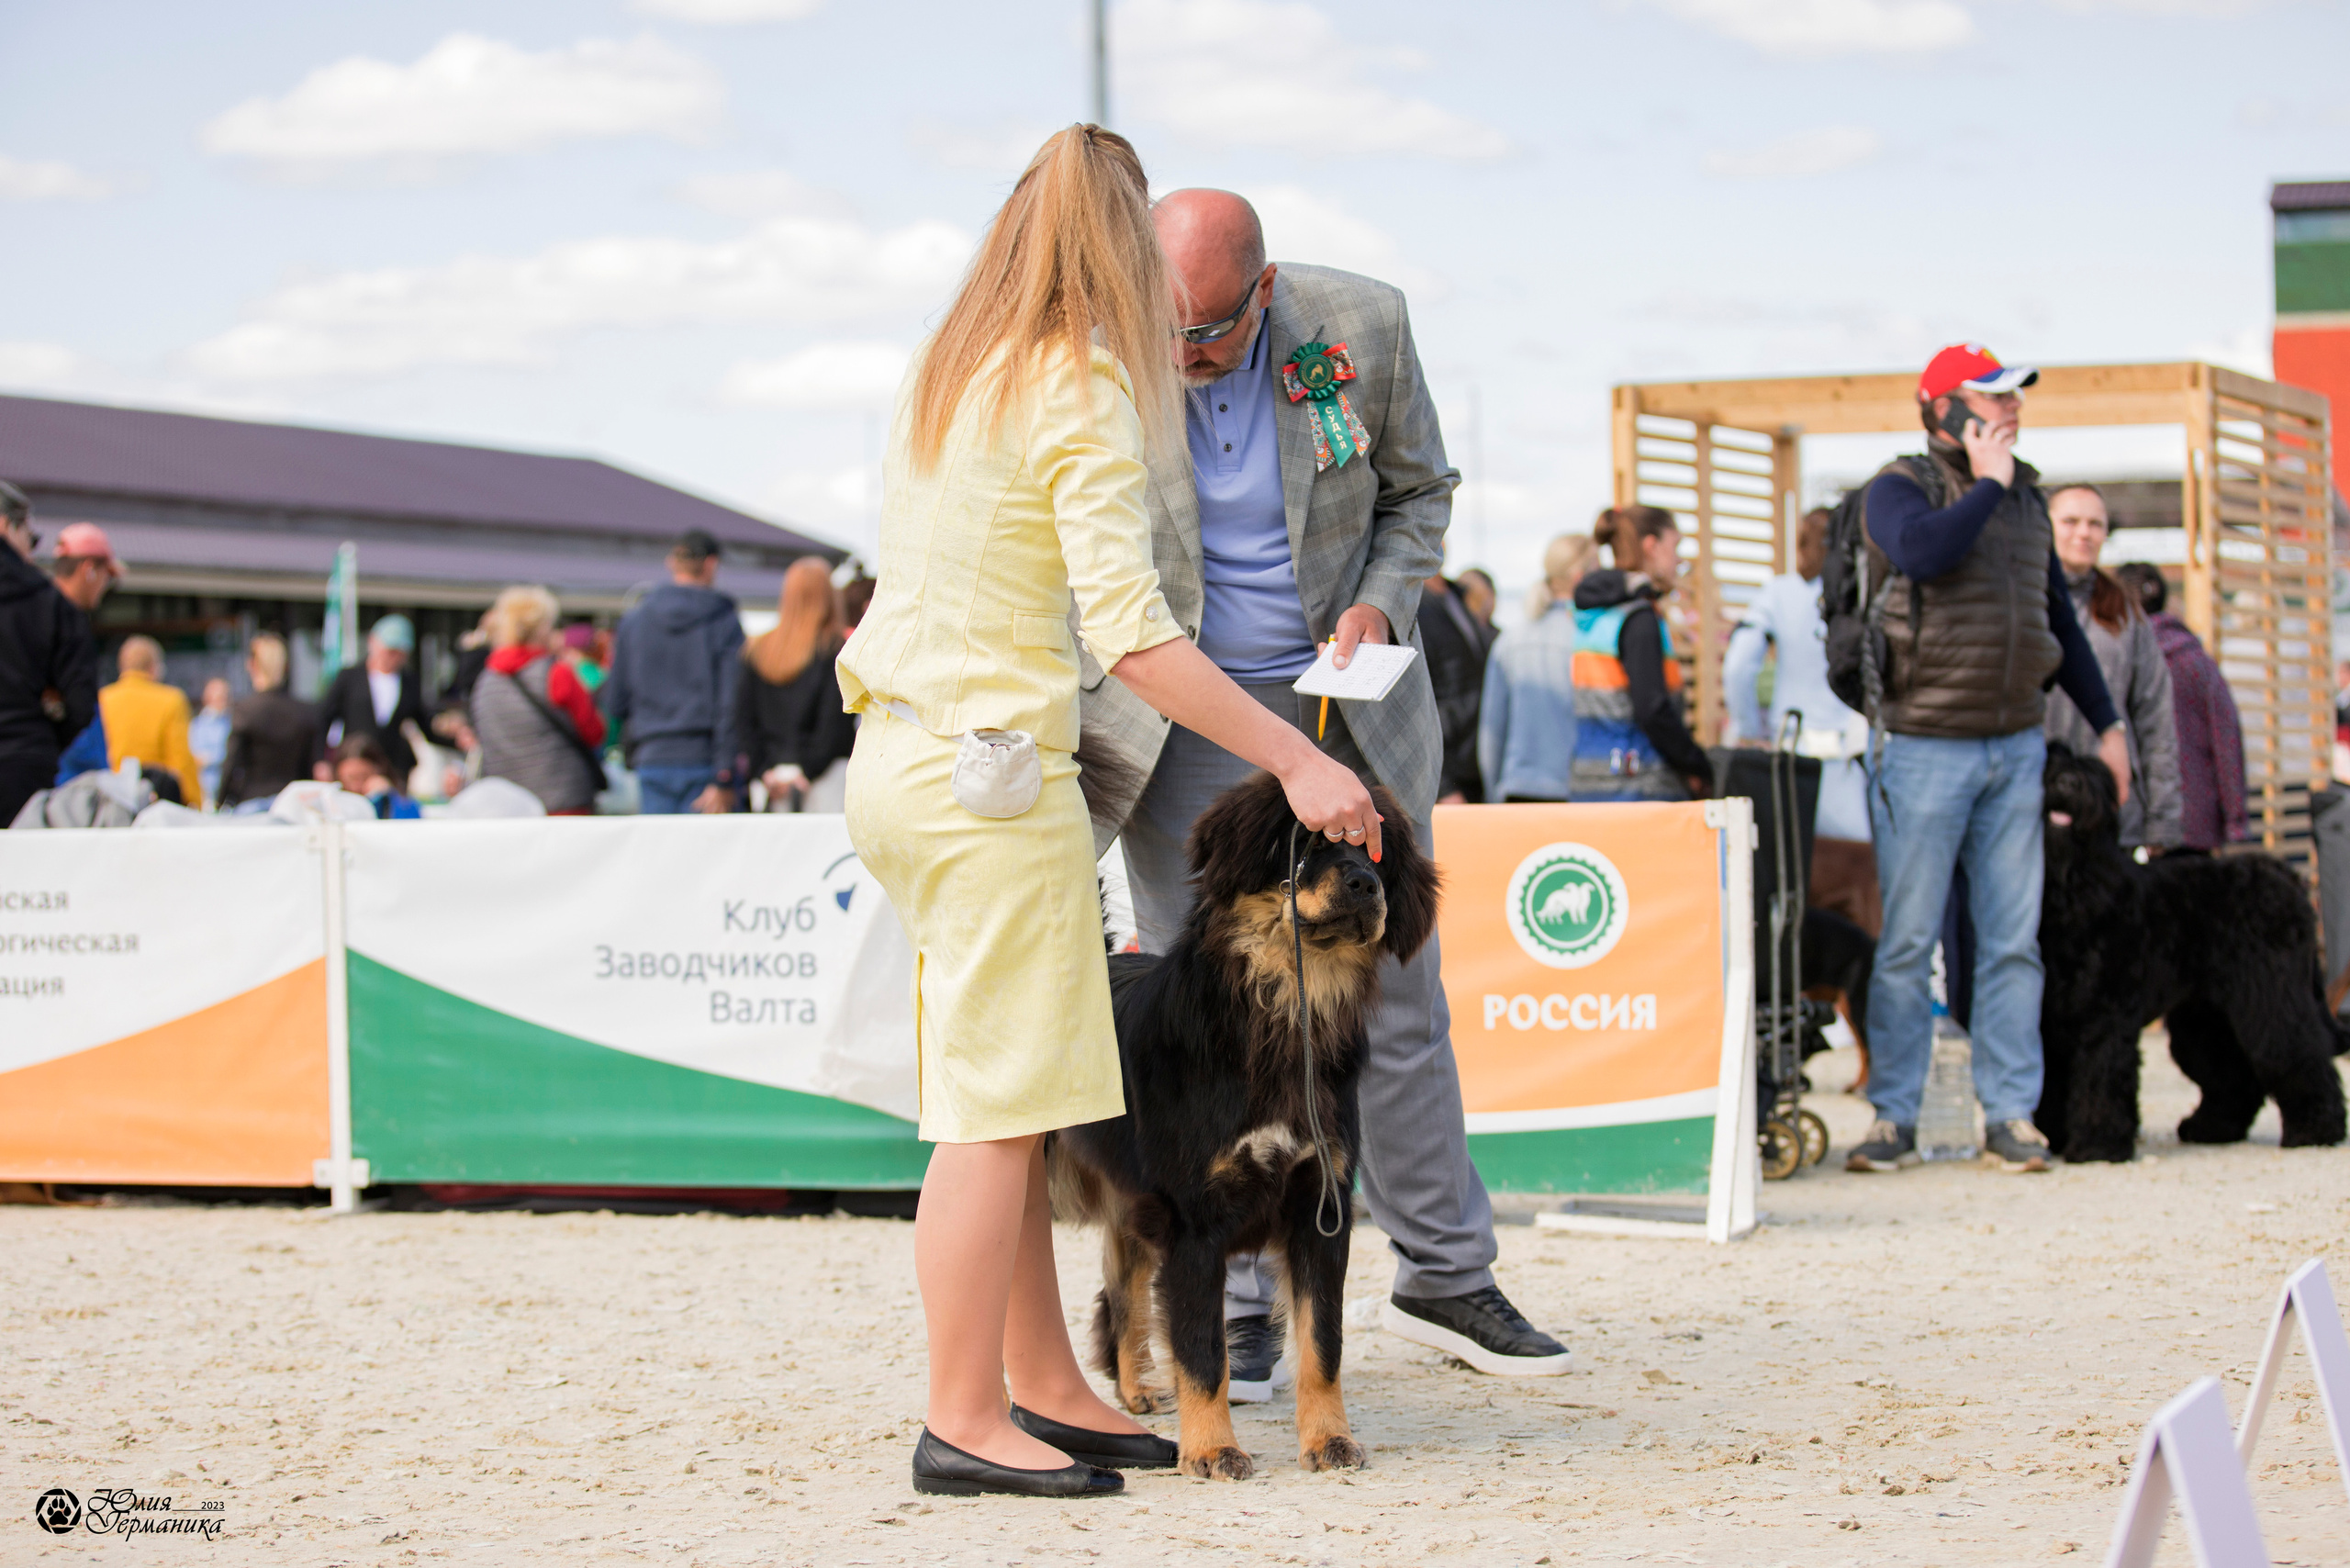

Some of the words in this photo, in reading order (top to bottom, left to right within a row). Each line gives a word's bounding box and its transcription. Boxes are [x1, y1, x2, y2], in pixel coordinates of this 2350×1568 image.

[1325, 405, 1348, 450] СУДЬЯ
[0, 890, 70, 912] ская
[724, 895, 817, 939] Клуб
[595, 945, 818, 983] Заводчиков
[710, 991, 816, 1025] Валта
[1483, 993, 1657, 1031] РОССИЯ
